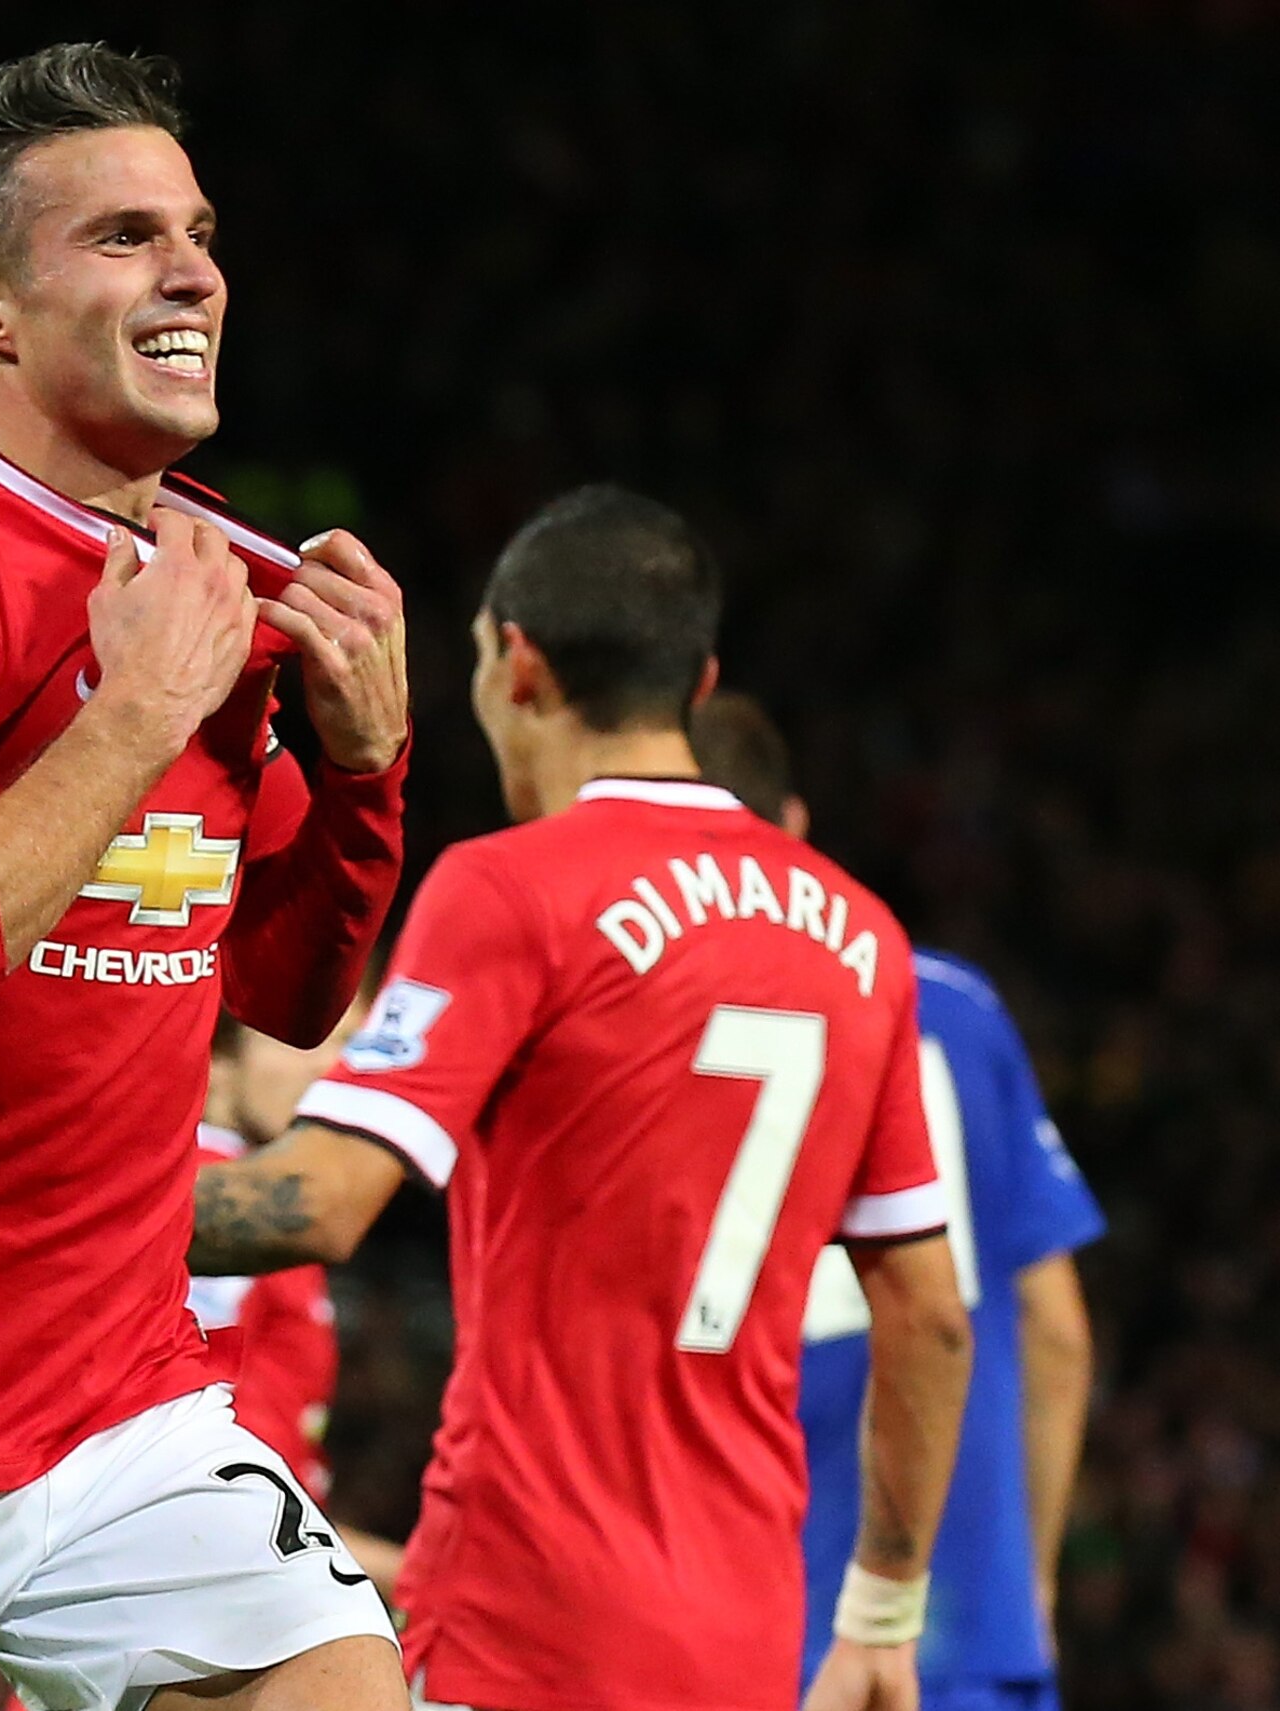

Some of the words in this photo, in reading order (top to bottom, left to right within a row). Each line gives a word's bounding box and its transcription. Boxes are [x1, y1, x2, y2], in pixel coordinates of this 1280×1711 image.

[596, 877, 683, 975] DI
[669, 853, 878, 997] MARIA
[675, 1004, 827, 1353] 7
